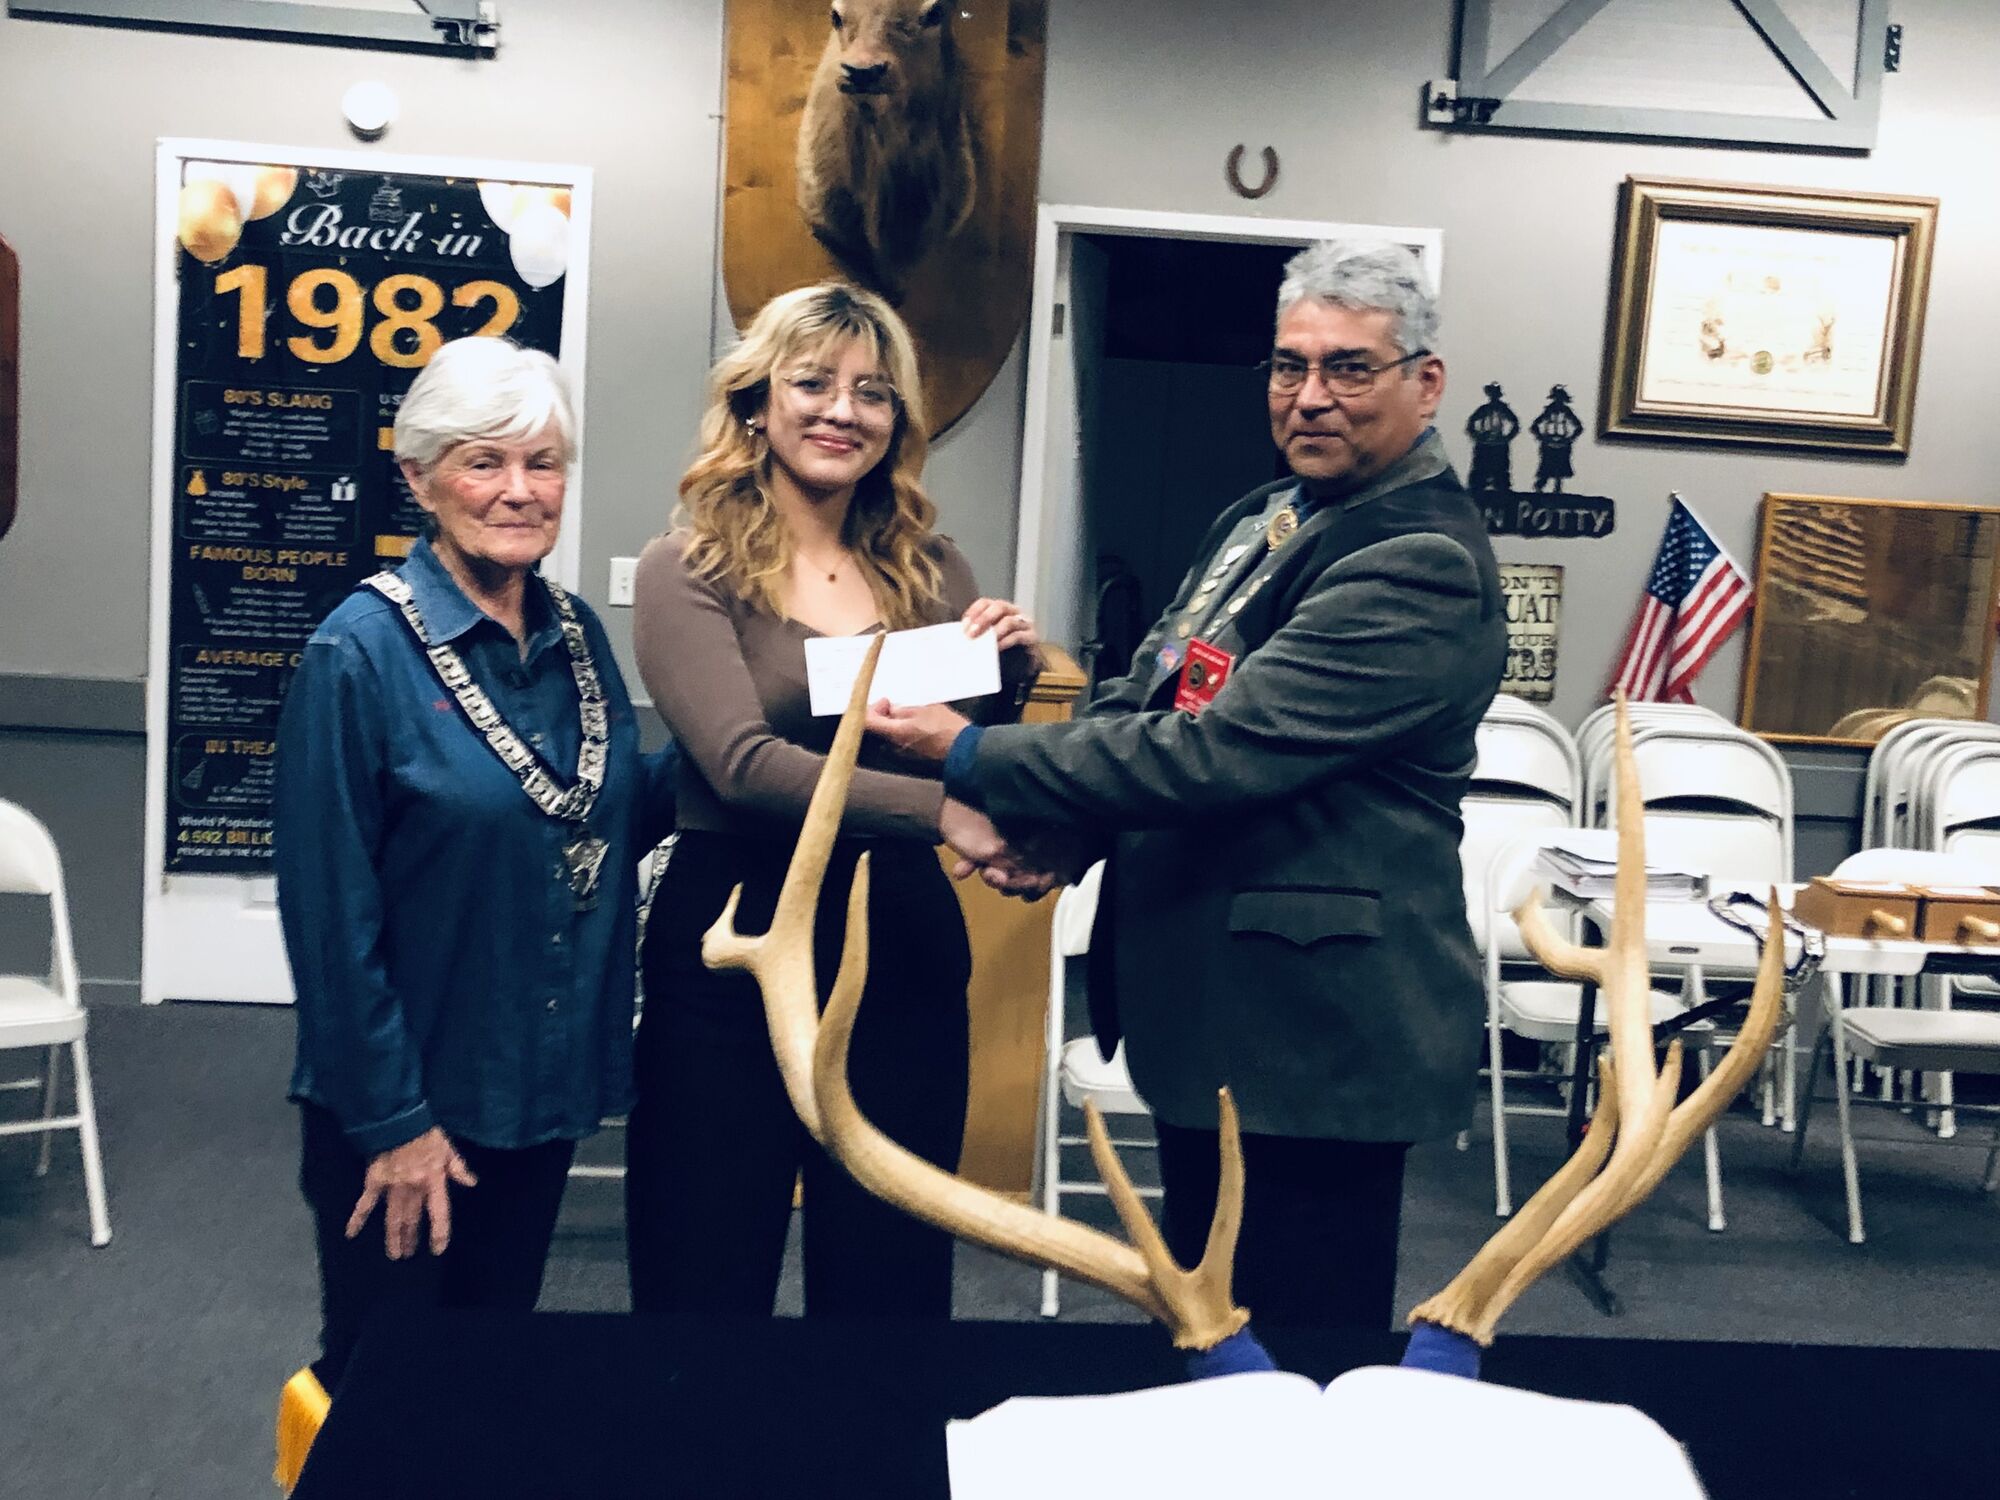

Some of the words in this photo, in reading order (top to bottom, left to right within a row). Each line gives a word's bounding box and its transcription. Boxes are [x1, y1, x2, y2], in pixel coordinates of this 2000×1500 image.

[279, 202, 422, 255] Back
[431, 221, 484, 258] in
[214, 264, 520, 369] 1982
[267, 391, 333, 410] SLANG
[262, 473, 309, 491] Style
[190, 545, 273, 564] FAMOUS
[277, 550, 348, 567] PEOPLE
[242, 566, 298, 582] BORN
[1504, 593, 1561, 623] UAT
[195, 649, 285, 667] AVERAGE
[178, 815, 216, 828] World
